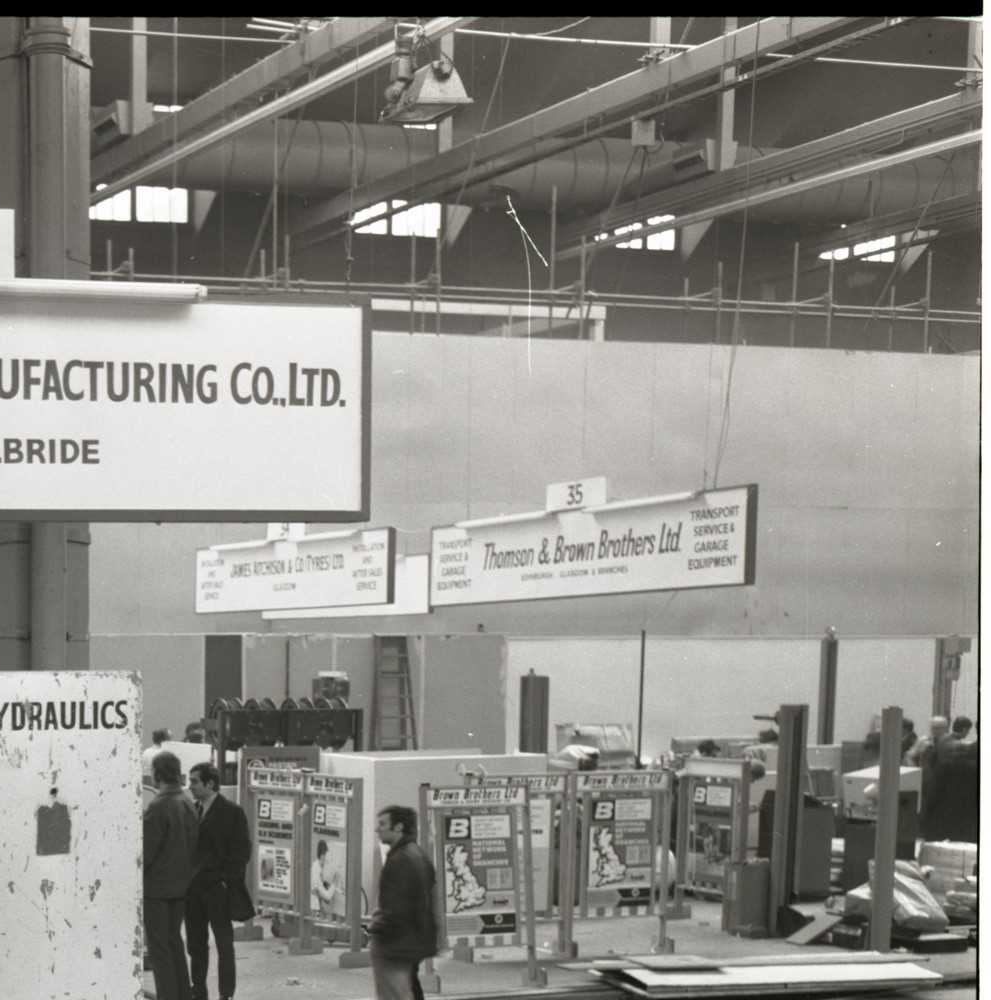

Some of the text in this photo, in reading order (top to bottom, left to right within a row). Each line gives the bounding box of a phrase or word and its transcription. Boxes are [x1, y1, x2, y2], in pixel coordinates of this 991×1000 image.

[566, 484, 583, 505] 35
[694, 523, 728, 536] SERVICE
[483, 521, 682, 570] Thomson & Brown Brothers Ltd.
[433, 788, 459, 801] Brown
[464, 787, 501, 800] Brothers
[449, 818, 469, 838] B
